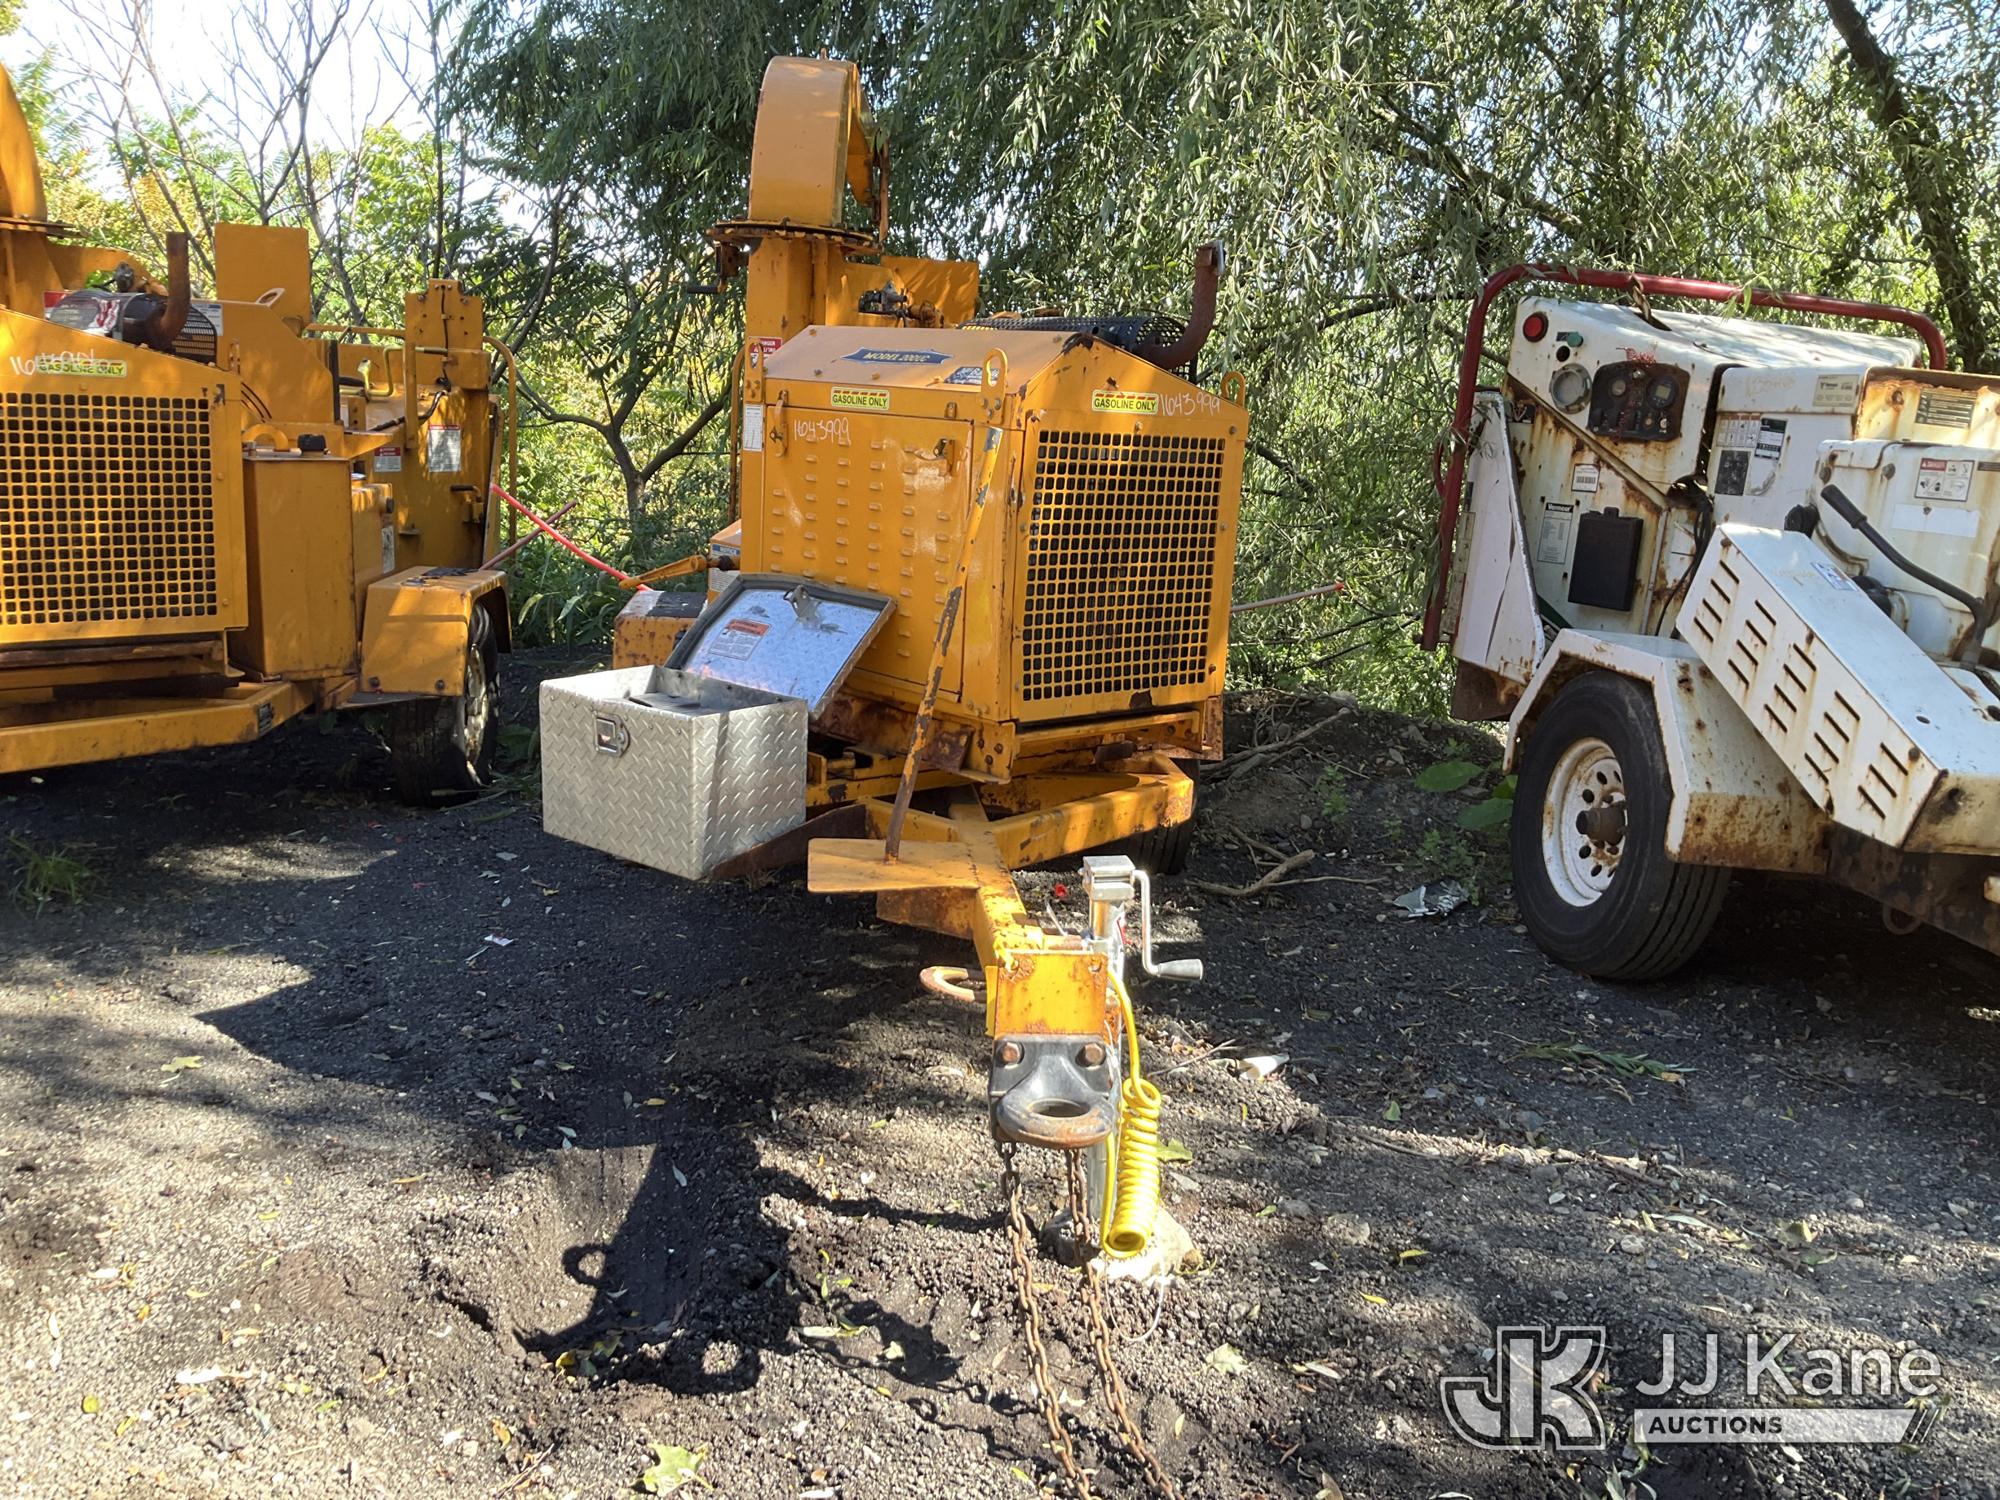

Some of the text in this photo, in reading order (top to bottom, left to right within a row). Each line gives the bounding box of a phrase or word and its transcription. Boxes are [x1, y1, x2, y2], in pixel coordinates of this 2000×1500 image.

[863, 352, 898, 361] MODEL
[96, 365, 125, 376] ONLY
[832, 394, 888, 407] GASOLINE ONLY
[1094, 397, 1157, 411] GASOLINE ONLY
[1160, 391, 1221, 417] 1643999
